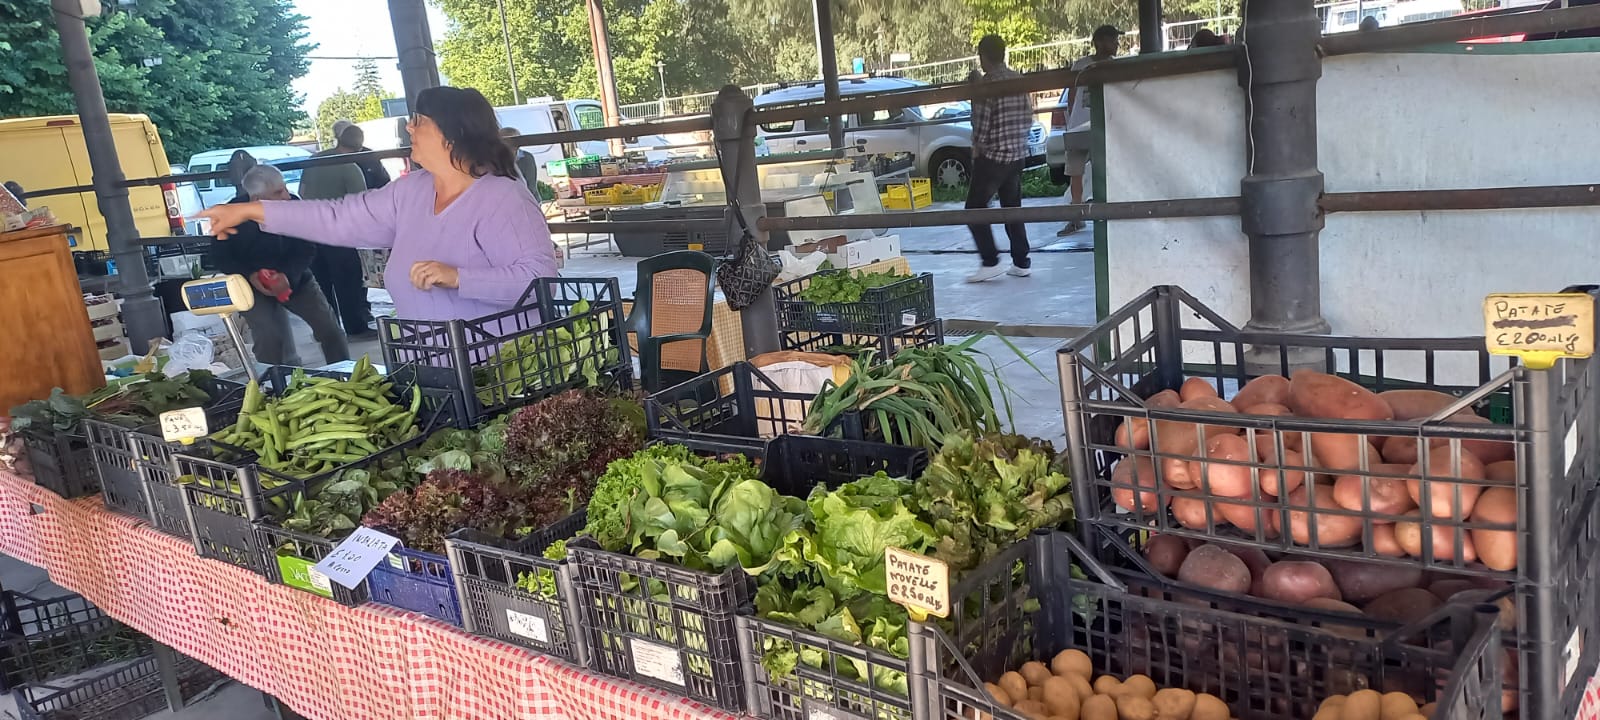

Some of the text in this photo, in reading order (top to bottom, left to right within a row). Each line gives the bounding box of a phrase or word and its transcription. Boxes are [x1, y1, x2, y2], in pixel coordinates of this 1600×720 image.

[1494, 300, 1566, 319] PATATE
[889, 554, 930, 575] PATATE
[889, 571, 938, 591] NOVELLE
